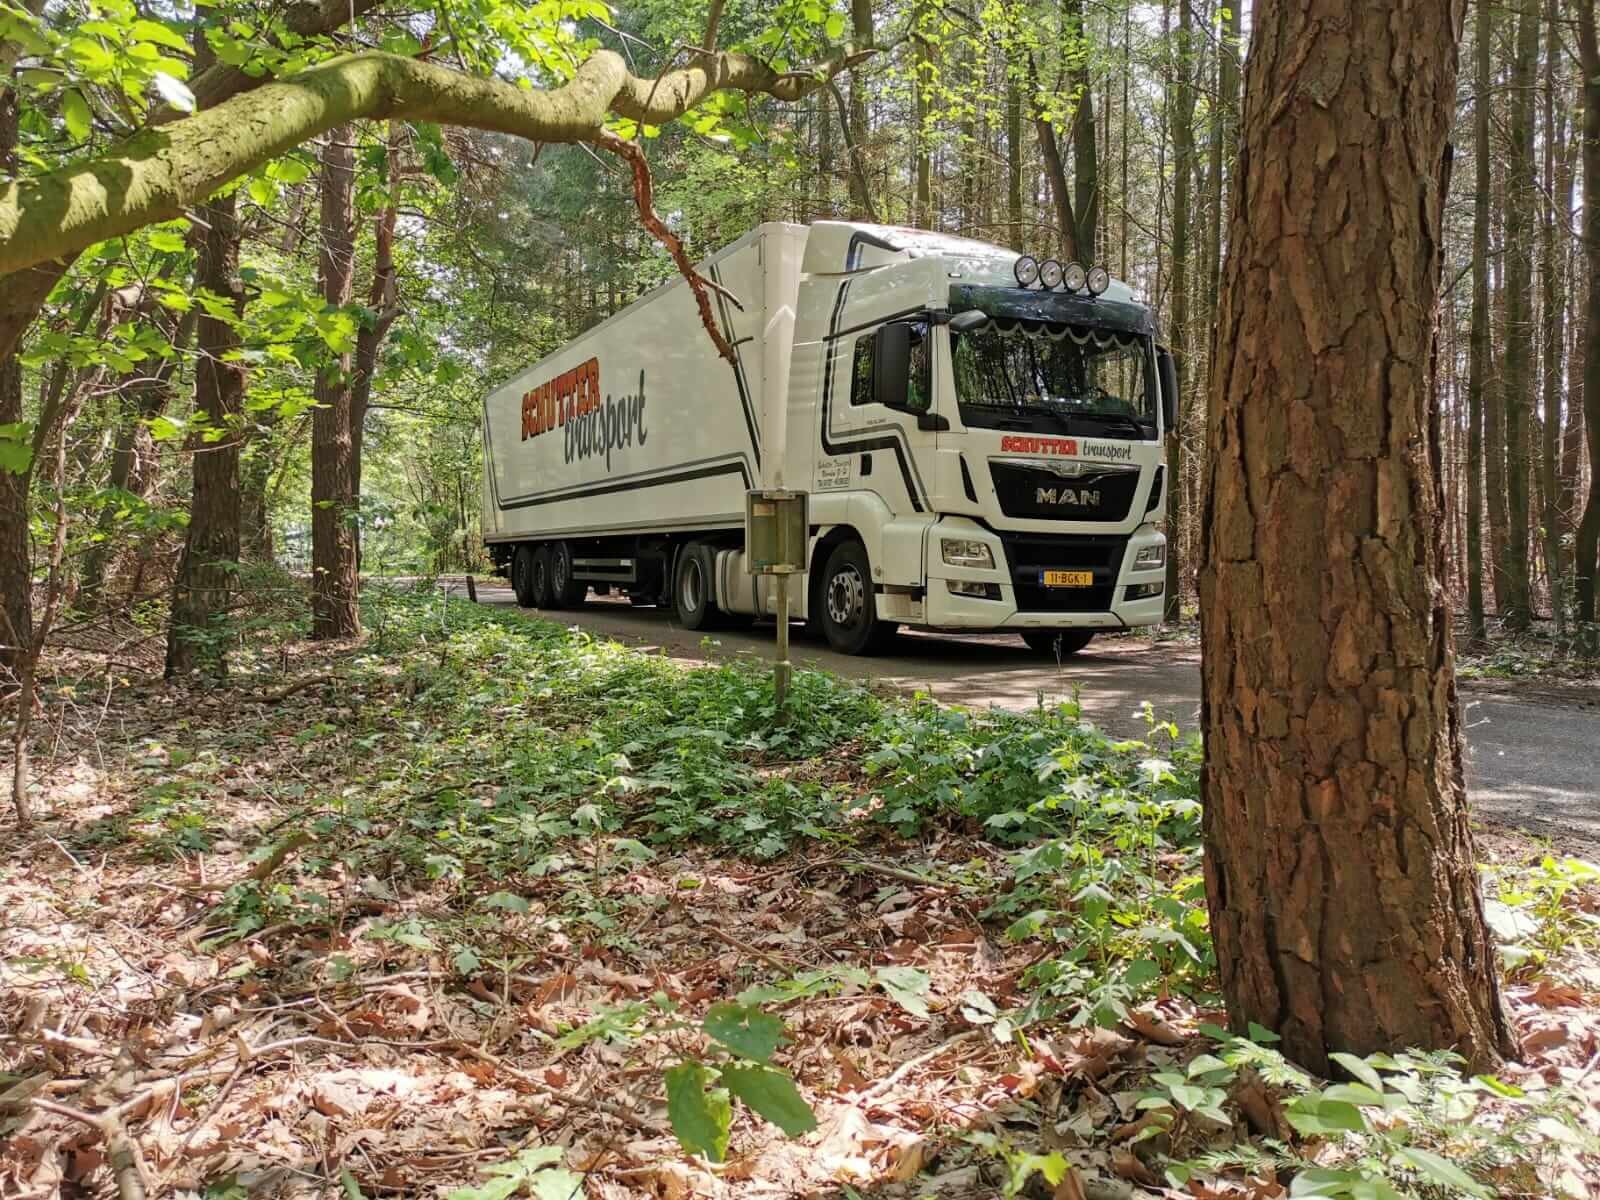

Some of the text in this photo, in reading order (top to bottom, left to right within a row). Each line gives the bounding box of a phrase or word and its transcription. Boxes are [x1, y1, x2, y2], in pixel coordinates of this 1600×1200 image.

[521, 356, 600, 441] SCHUTTER
[564, 368, 647, 472] transport
[1001, 435, 1132, 460] SCHUTTER transport
[1036, 487, 1101, 505] MAN
[1049, 572, 1088, 584] 11-BGK-1
